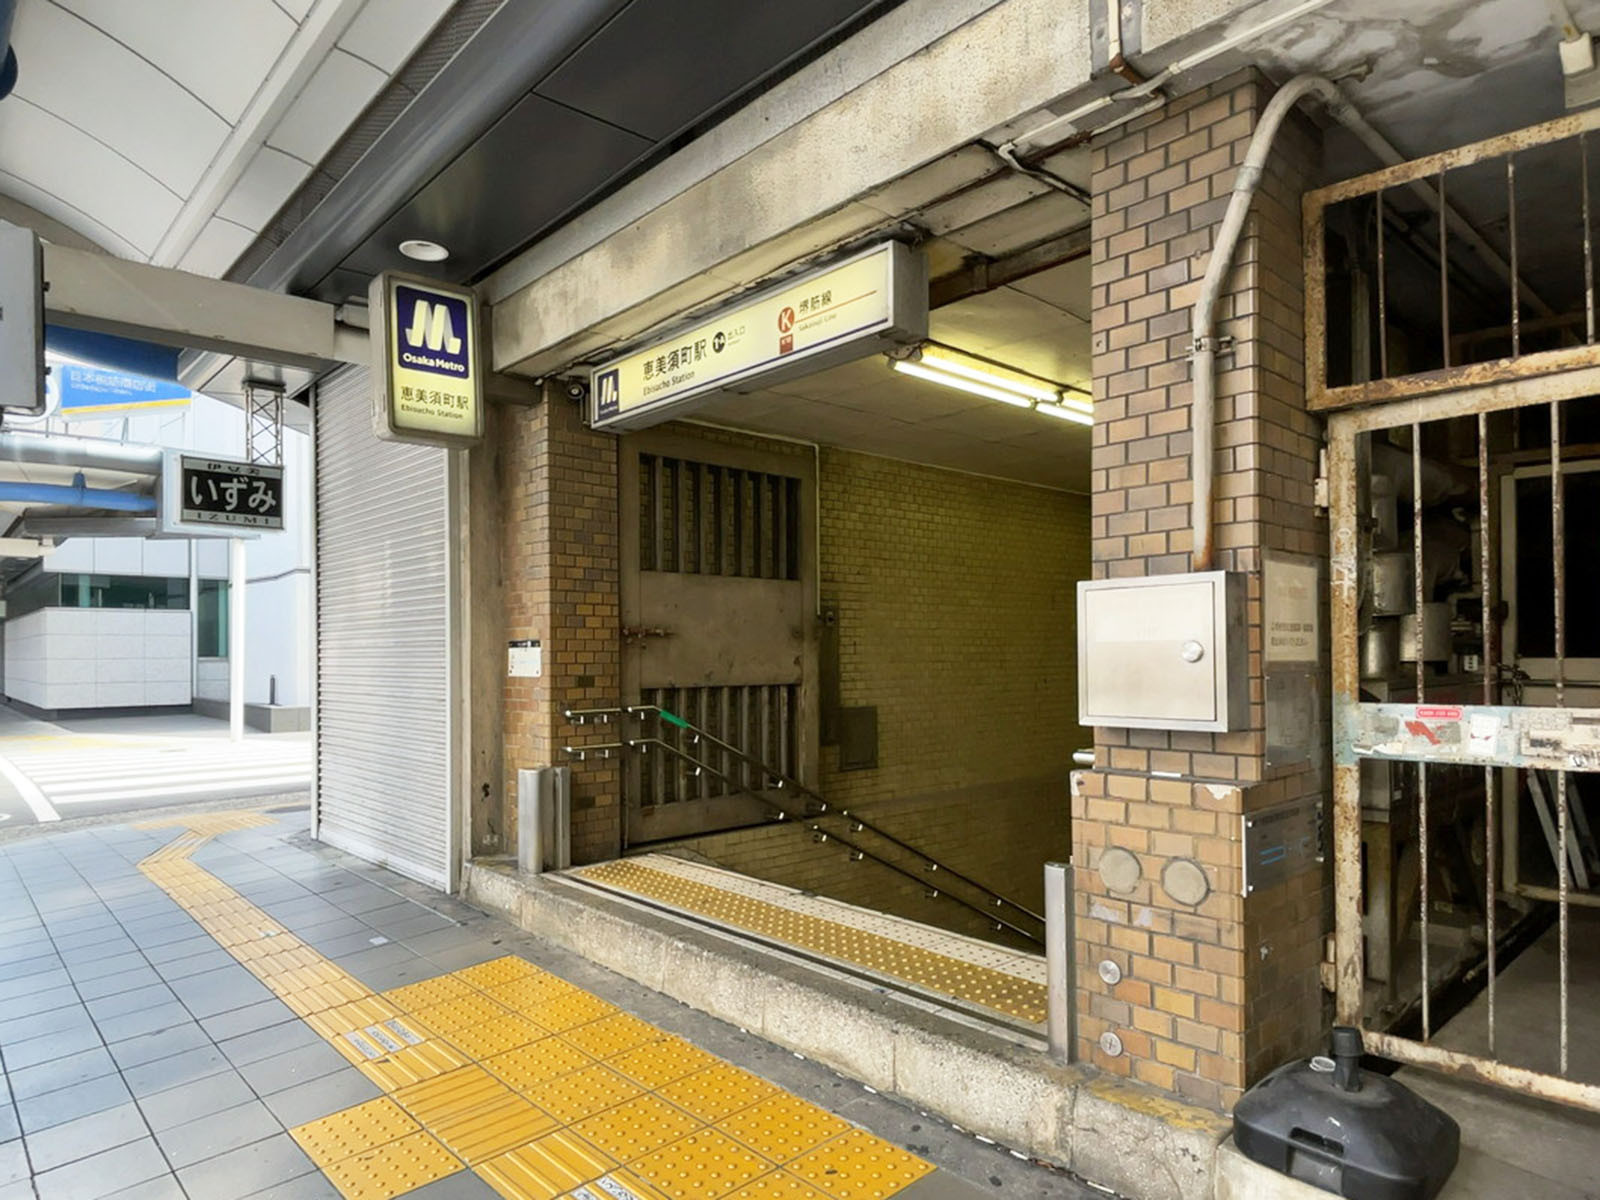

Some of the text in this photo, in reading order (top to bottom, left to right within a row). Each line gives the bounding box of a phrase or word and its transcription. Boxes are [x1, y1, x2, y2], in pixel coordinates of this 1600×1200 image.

[402, 353, 465, 373] Osaka Metro
[643, 339, 707, 381] 恵美須町駅
[671, 370, 695, 387] Station
[401, 386, 469, 410] 恵美須町駅
[437, 408, 463, 419] Station
[191, 475, 277, 514] いずみ
[197, 511, 269, 524] IZUMI
